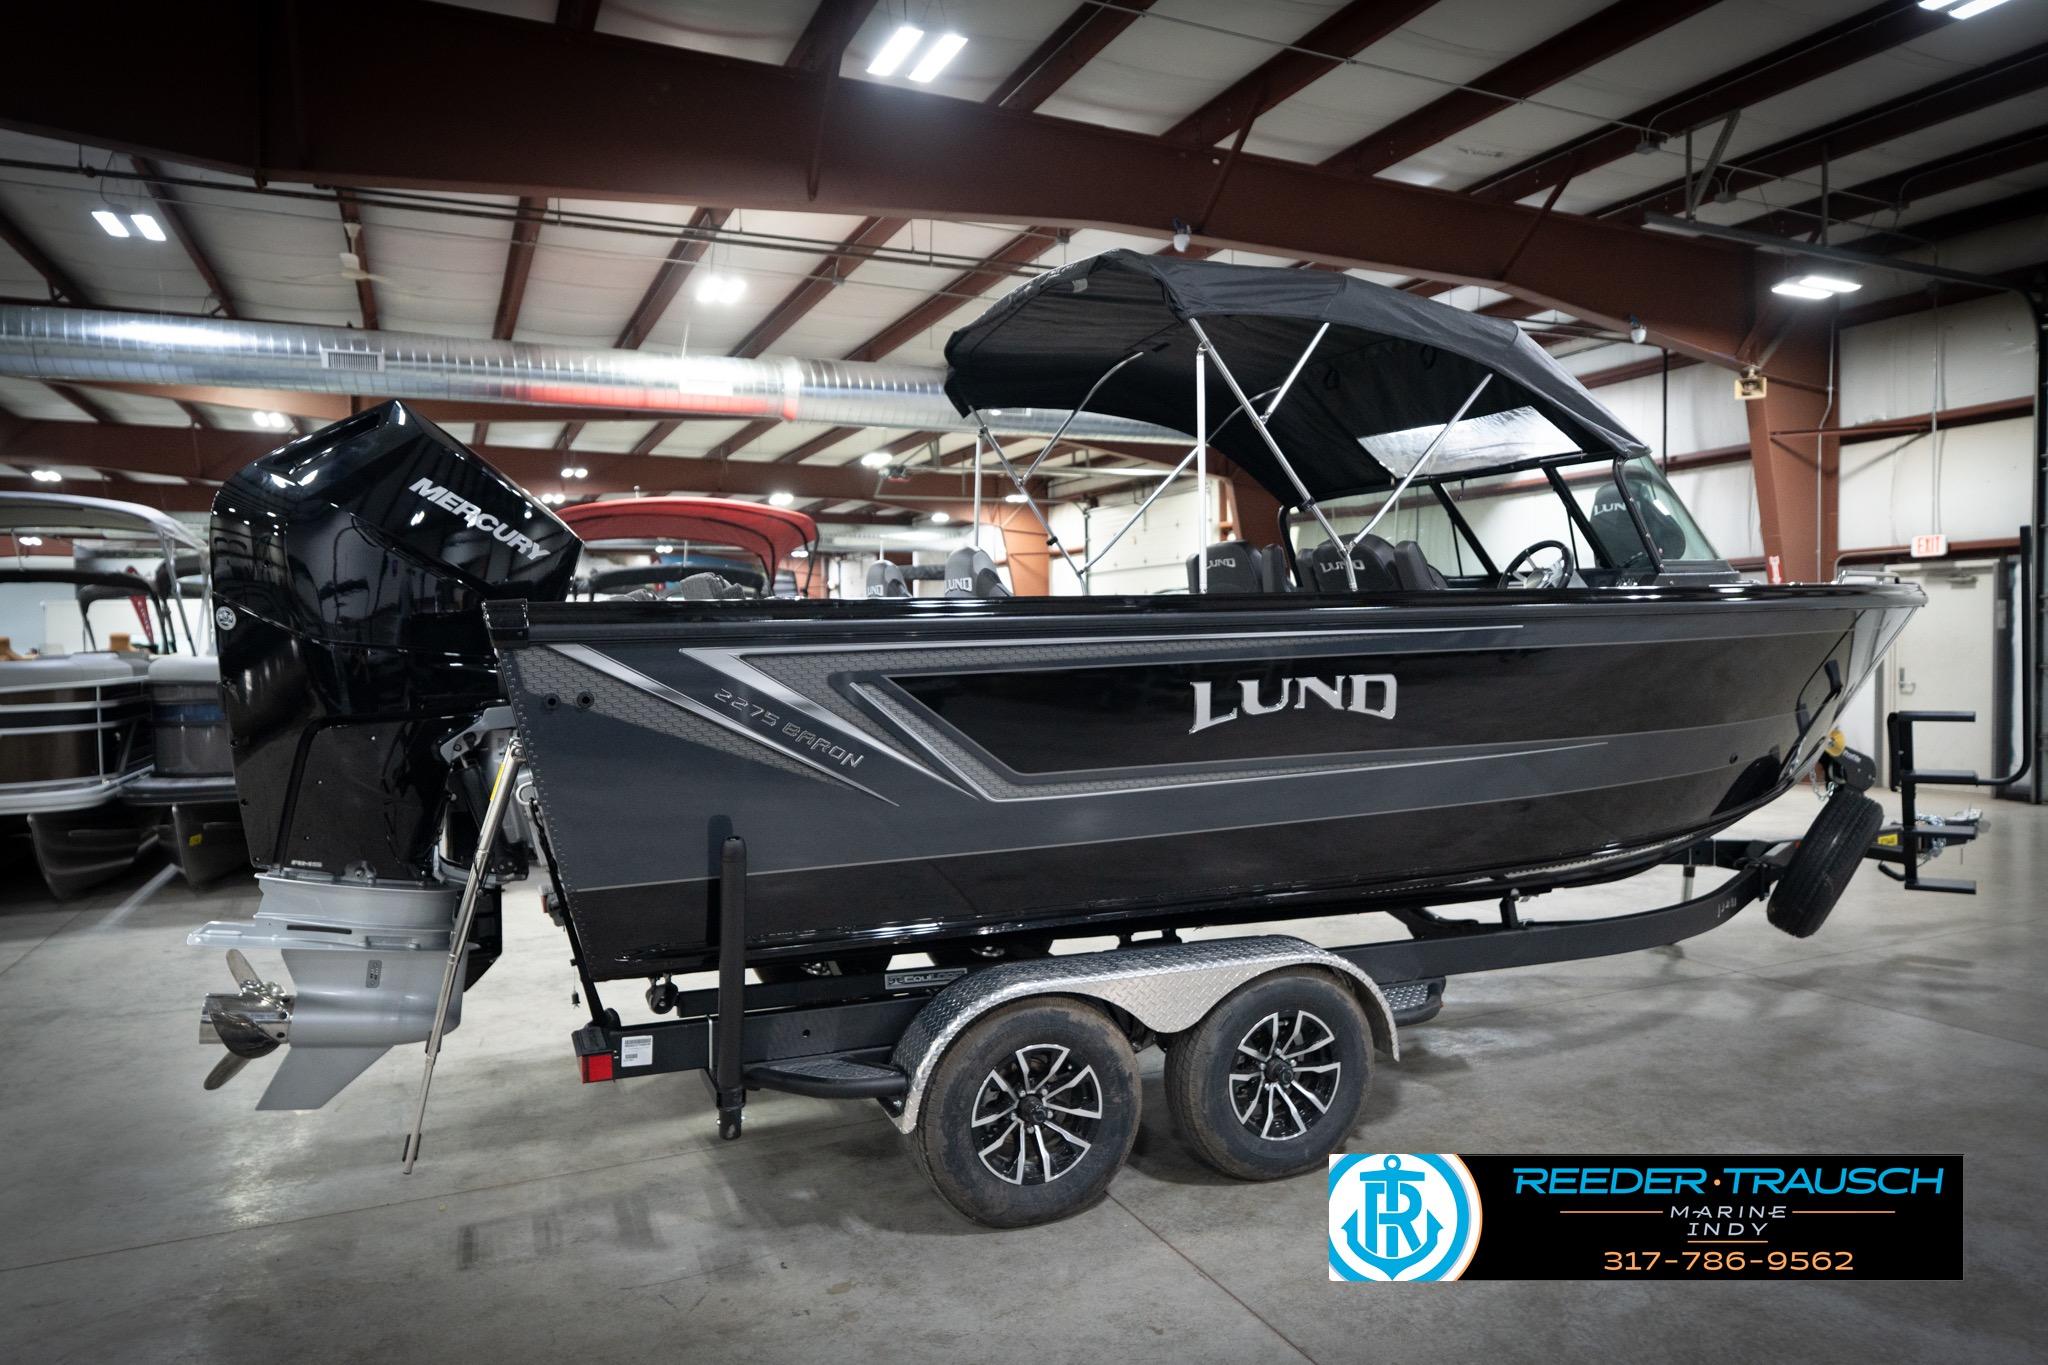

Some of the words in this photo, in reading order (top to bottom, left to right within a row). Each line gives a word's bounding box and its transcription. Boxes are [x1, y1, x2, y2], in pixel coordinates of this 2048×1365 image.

[408, 477, 551, 560] MERCURY
[1594, 501, 1641, 516] LUN
[1206, 558, 1236, 570] UND
[1917, 536, 1942, 553] EXIT
[1189, 674, 1397, 735] LUND
[714, 688, 779, 727] 2275
[782, 722, 864, 768] BARON
